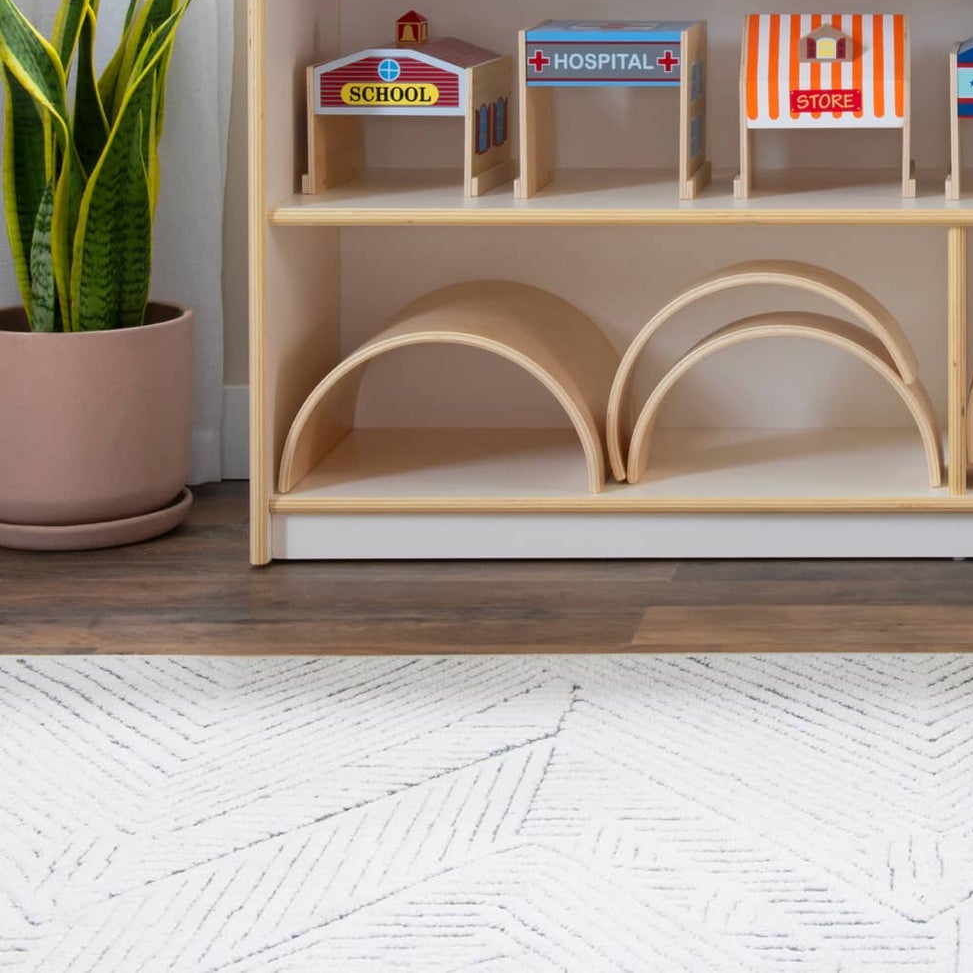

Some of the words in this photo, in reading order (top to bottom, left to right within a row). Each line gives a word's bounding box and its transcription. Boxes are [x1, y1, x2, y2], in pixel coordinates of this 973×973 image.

[554, 53, 654, 70] HOSPITAL
[349, 86, 432, 103] SCHOOL
[796, 93, 855, 110] STORE
